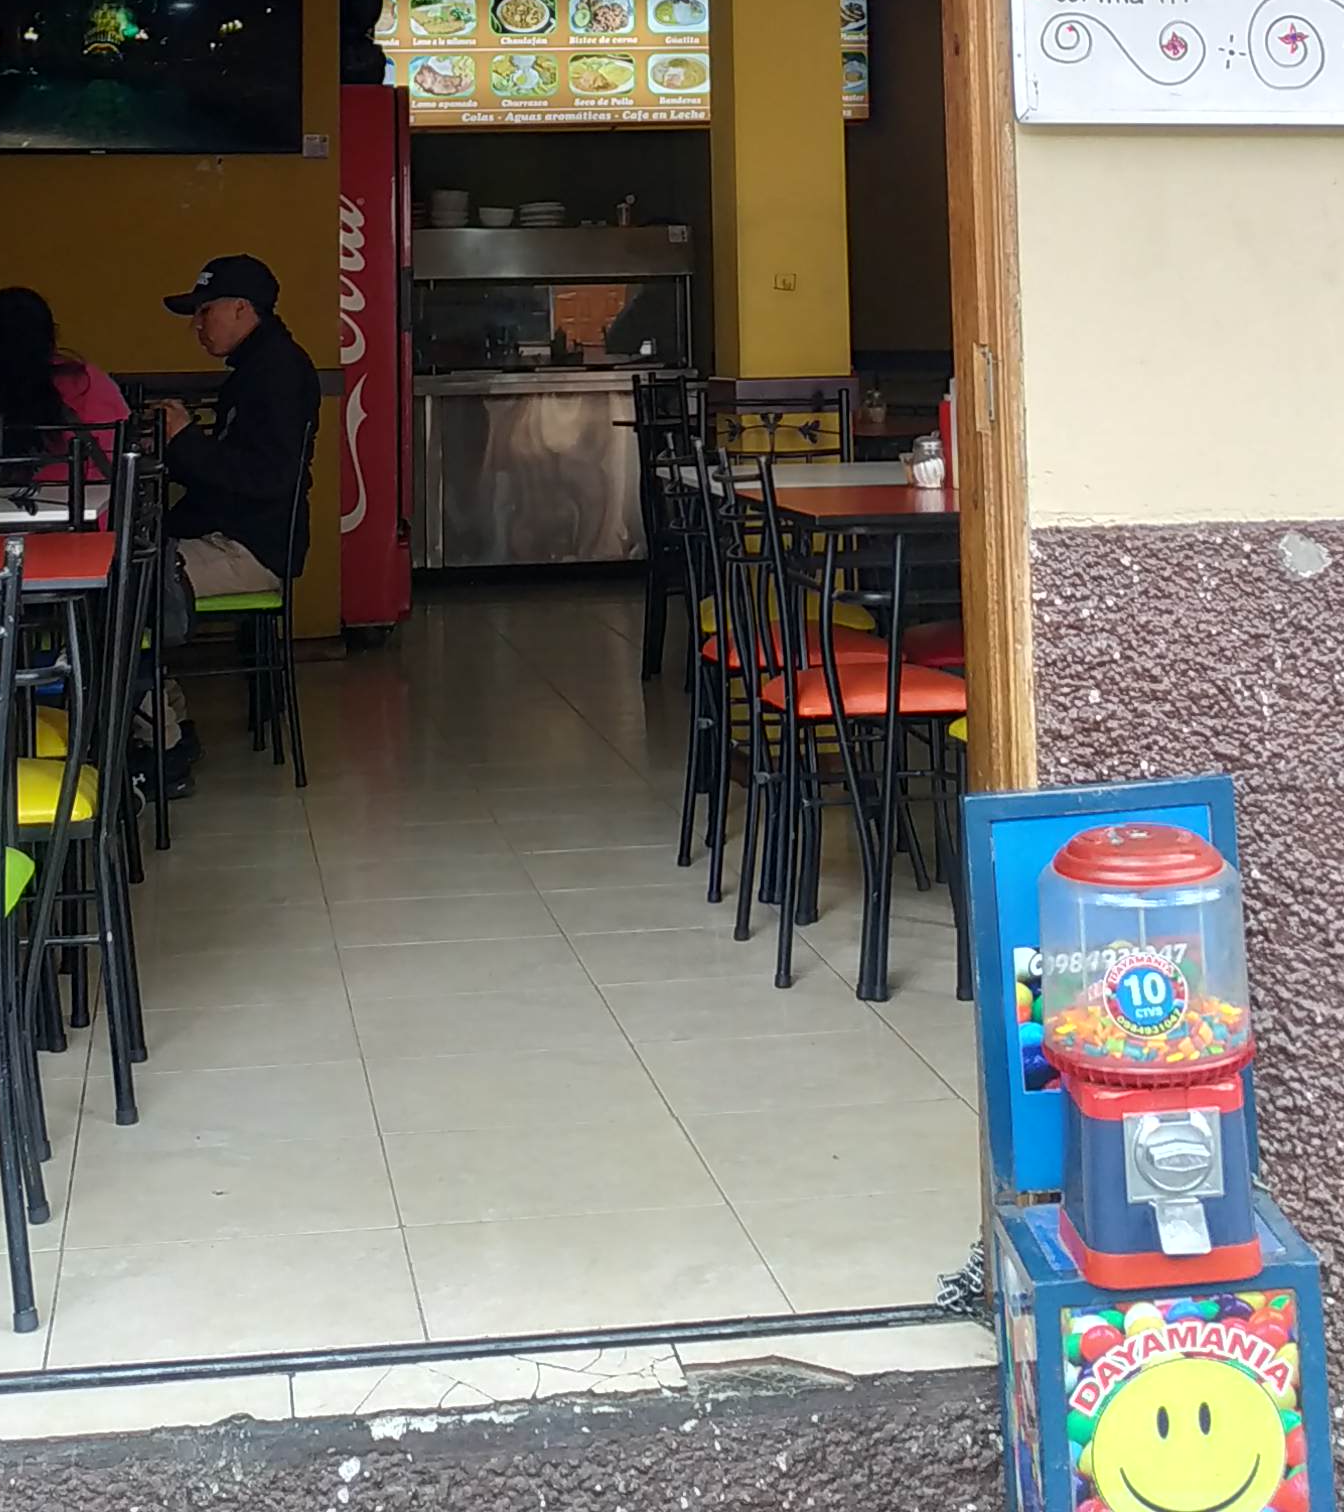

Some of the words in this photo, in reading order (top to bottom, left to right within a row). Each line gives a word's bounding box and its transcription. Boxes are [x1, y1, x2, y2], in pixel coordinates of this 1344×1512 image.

[462, 113, 494, 122] Colas
[505, 113, 542, 124] Aguas
[1123, 971, 1167, 1006] 10
[1070, 1321, 1293, 1416] DAYAMANIA
